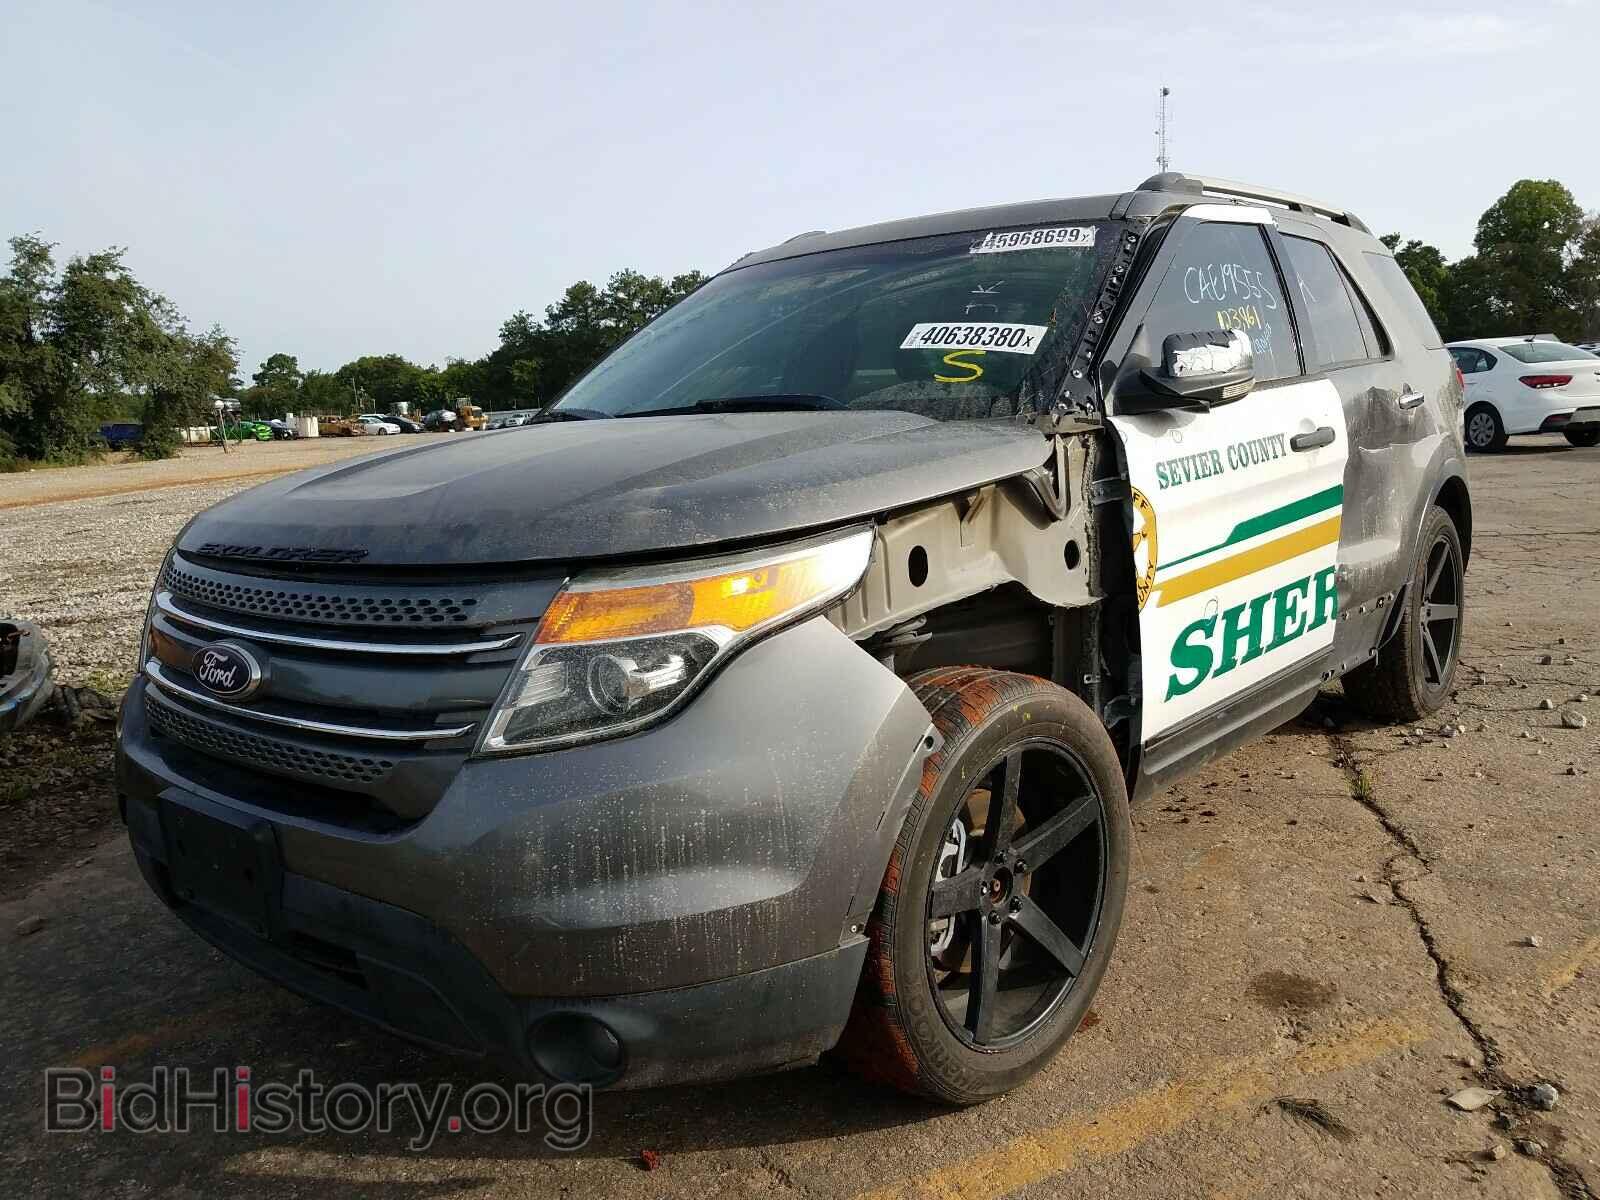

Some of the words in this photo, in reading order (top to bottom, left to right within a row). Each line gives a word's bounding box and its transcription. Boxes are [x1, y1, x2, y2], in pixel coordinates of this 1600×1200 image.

[933, 350, 987, 383] S
[1156, 449, 1225, 490] SEVIER
[1226, 432, 1287, 471] COUNTY
[199, 651, 238, 688] Ford
